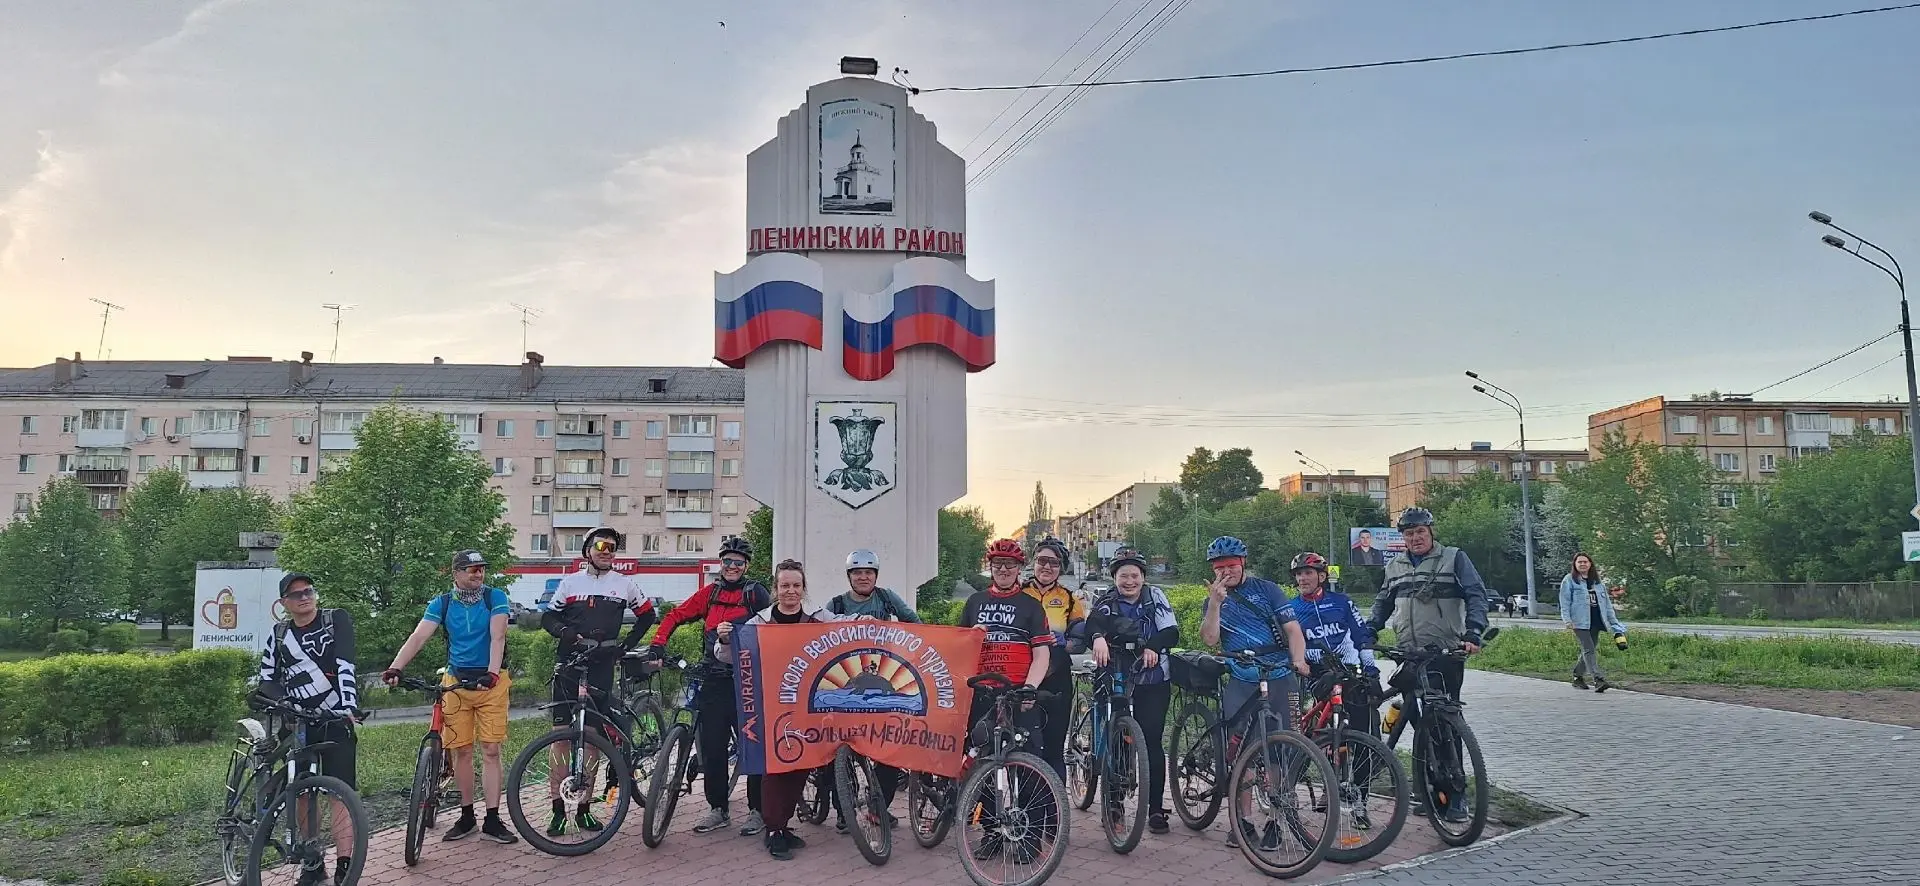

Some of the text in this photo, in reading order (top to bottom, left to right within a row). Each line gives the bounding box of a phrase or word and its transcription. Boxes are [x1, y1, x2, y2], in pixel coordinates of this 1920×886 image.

[750, 222, 964, 255] ЛЕНИНСКИЙ РАЙОН
[984, 603, 997, 611] AM
[999, 603, 1016, 613] NOT
[977, 612, 1016, 625] SLOW
[200, 632, 254, 642] ЛЕНИНСКИЙ
[997, 632, 1011, 641] ON
[1305, 622, 1345, 640] ASML
[779, 623, 956, 709] школа велосипедного туризма
[740, 649, 755, 713] EVRAZEN
